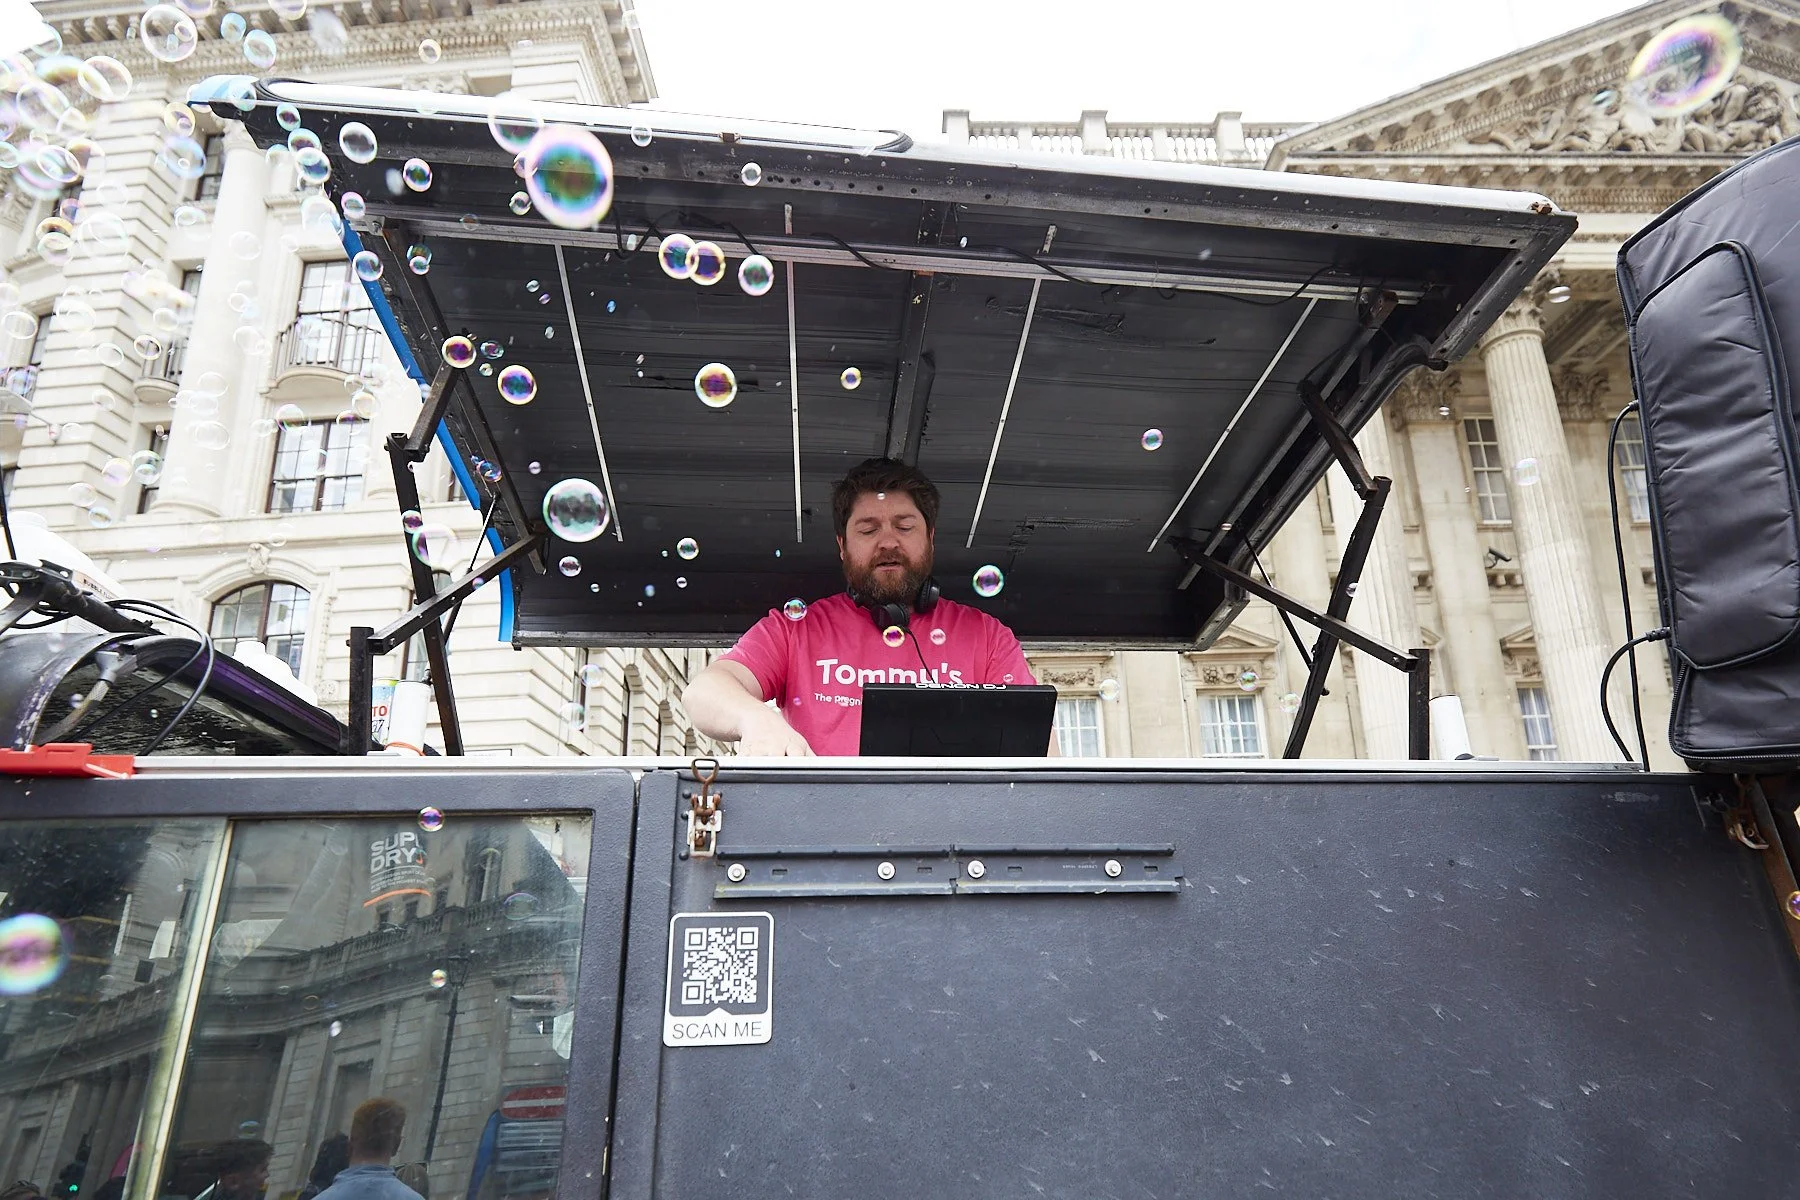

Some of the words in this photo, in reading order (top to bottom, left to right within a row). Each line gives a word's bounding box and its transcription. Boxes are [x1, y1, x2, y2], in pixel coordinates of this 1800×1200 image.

[816, 658, 963, 688] Tommy's
[814, 692, 832, 703] The
[834, 695, 862, 707] pregn
[370, 831, 419, 857] SUP
[370, 847, 417, 873] DRY
[672, 1023, 727, 1039] SCAN
[734, 1021, 762, 1037] ME
